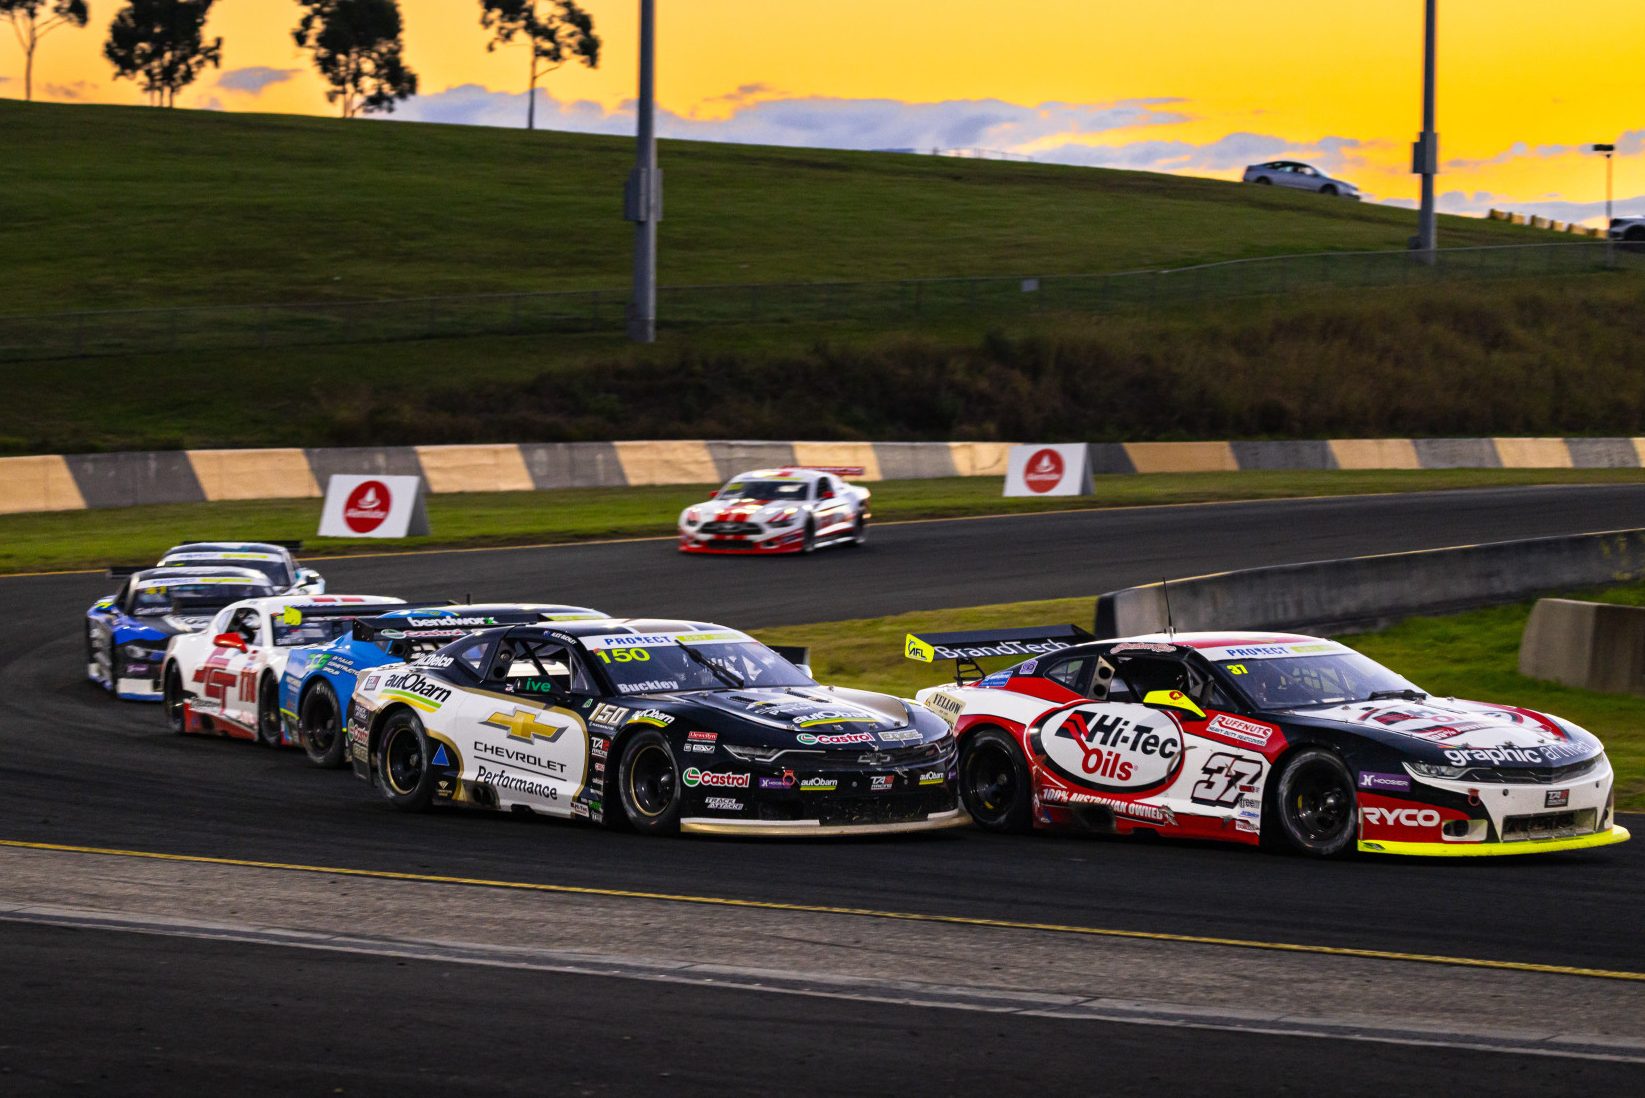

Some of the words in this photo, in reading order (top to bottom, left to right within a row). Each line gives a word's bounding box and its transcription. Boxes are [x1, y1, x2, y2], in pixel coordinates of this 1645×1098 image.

[596, 648, 651, 664] 150
[934, 639, 1071, 659] BrandTech
[1227, 664, 1249, 675] 37
[617, 680, 679, 694] Buckley
[588, 702, 630, 727] 150
[932, 693, 961, 714] YELLOW
[817, 731, 876, 745] Castrol
[1086, 714, 1178, 759] Hi-Tec
[1210, 715, 1272, 739] RUFFNUTS
[474, 741, 567, 773] CHEVROLET
[1081, 747, 1134, 781] Oils
[1444, 744, 1542, 767] graphic
[475, 765, 558, 800] Performance
[700, 771, 751, 788] Castrol
[1191, 751, 1263, 810] 37
[1373, 778, 1409, 787] HOOSIER
[1042, 788, 1069, 803] 100%
[1069, 792, 1126, 813] AUSTRALIAN
[1127, 802, 1164, 820] OWNED
[1358, 806, 1440, 828] RYCO
